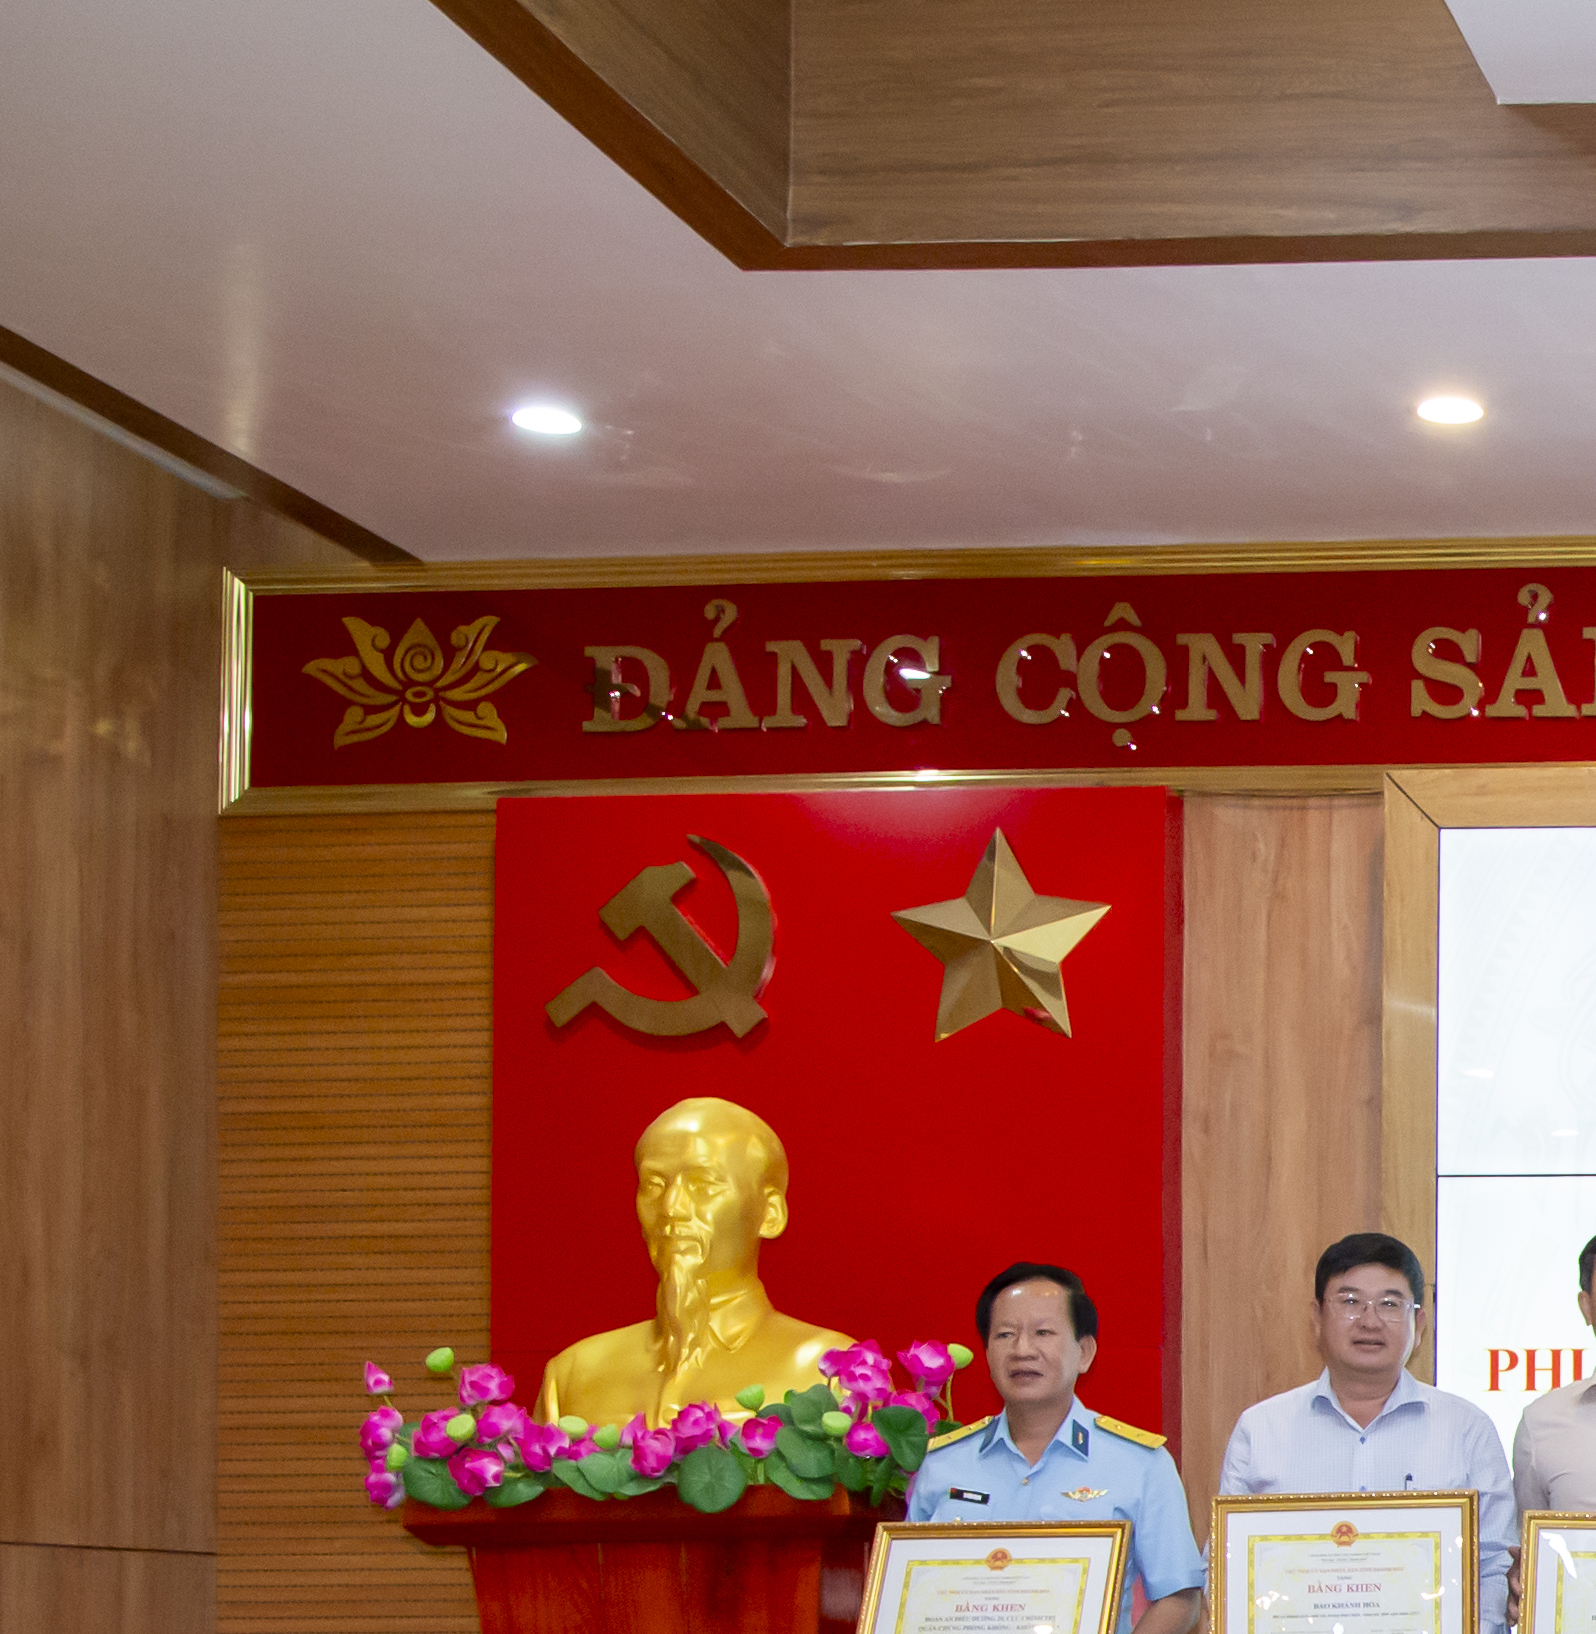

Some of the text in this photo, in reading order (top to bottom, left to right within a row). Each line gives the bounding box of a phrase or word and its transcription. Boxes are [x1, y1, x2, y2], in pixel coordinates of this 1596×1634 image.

[582, 599, 951, 733] ĐẢNG
[995, 601, 1371, 748] CỘNG
[1346, 1583, 1382, 1593] KHEN
